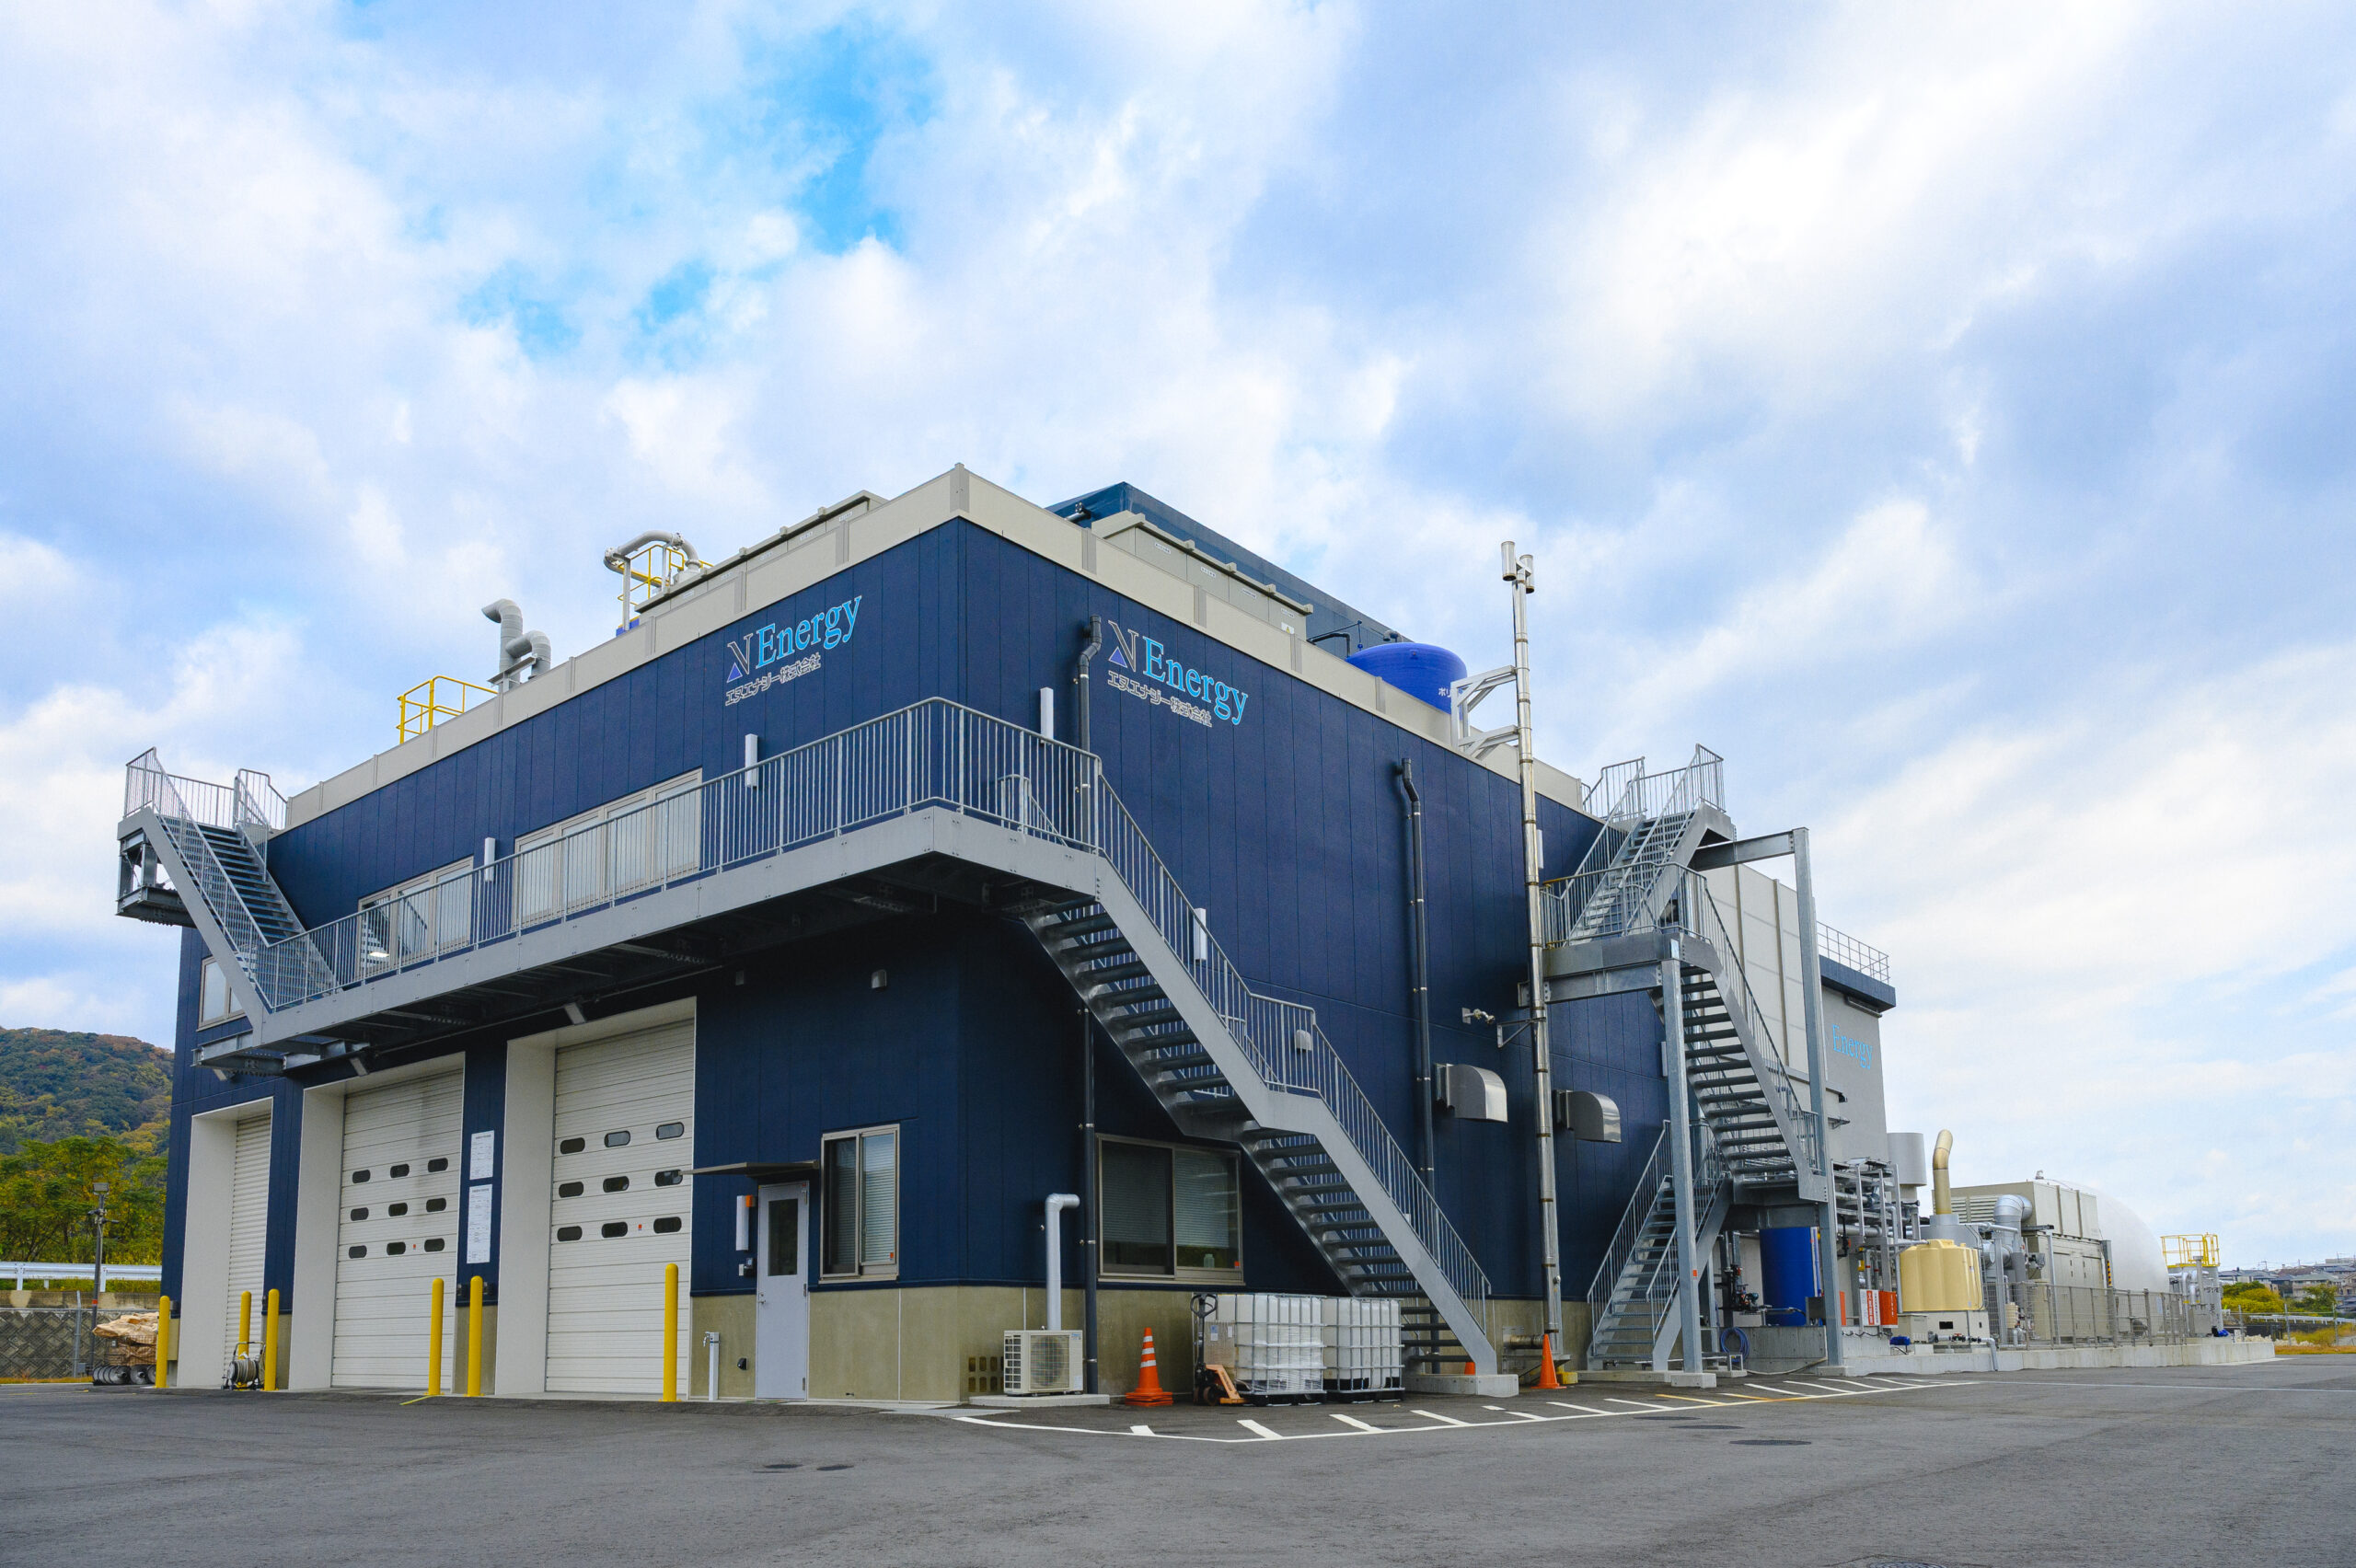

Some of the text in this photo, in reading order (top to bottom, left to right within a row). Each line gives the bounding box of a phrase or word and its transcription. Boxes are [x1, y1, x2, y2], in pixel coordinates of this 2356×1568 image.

[725, 652, 822, 707] エヌエナジー株式会社
[1107, 670, 1213, 728] エヌエナジー株式会社
